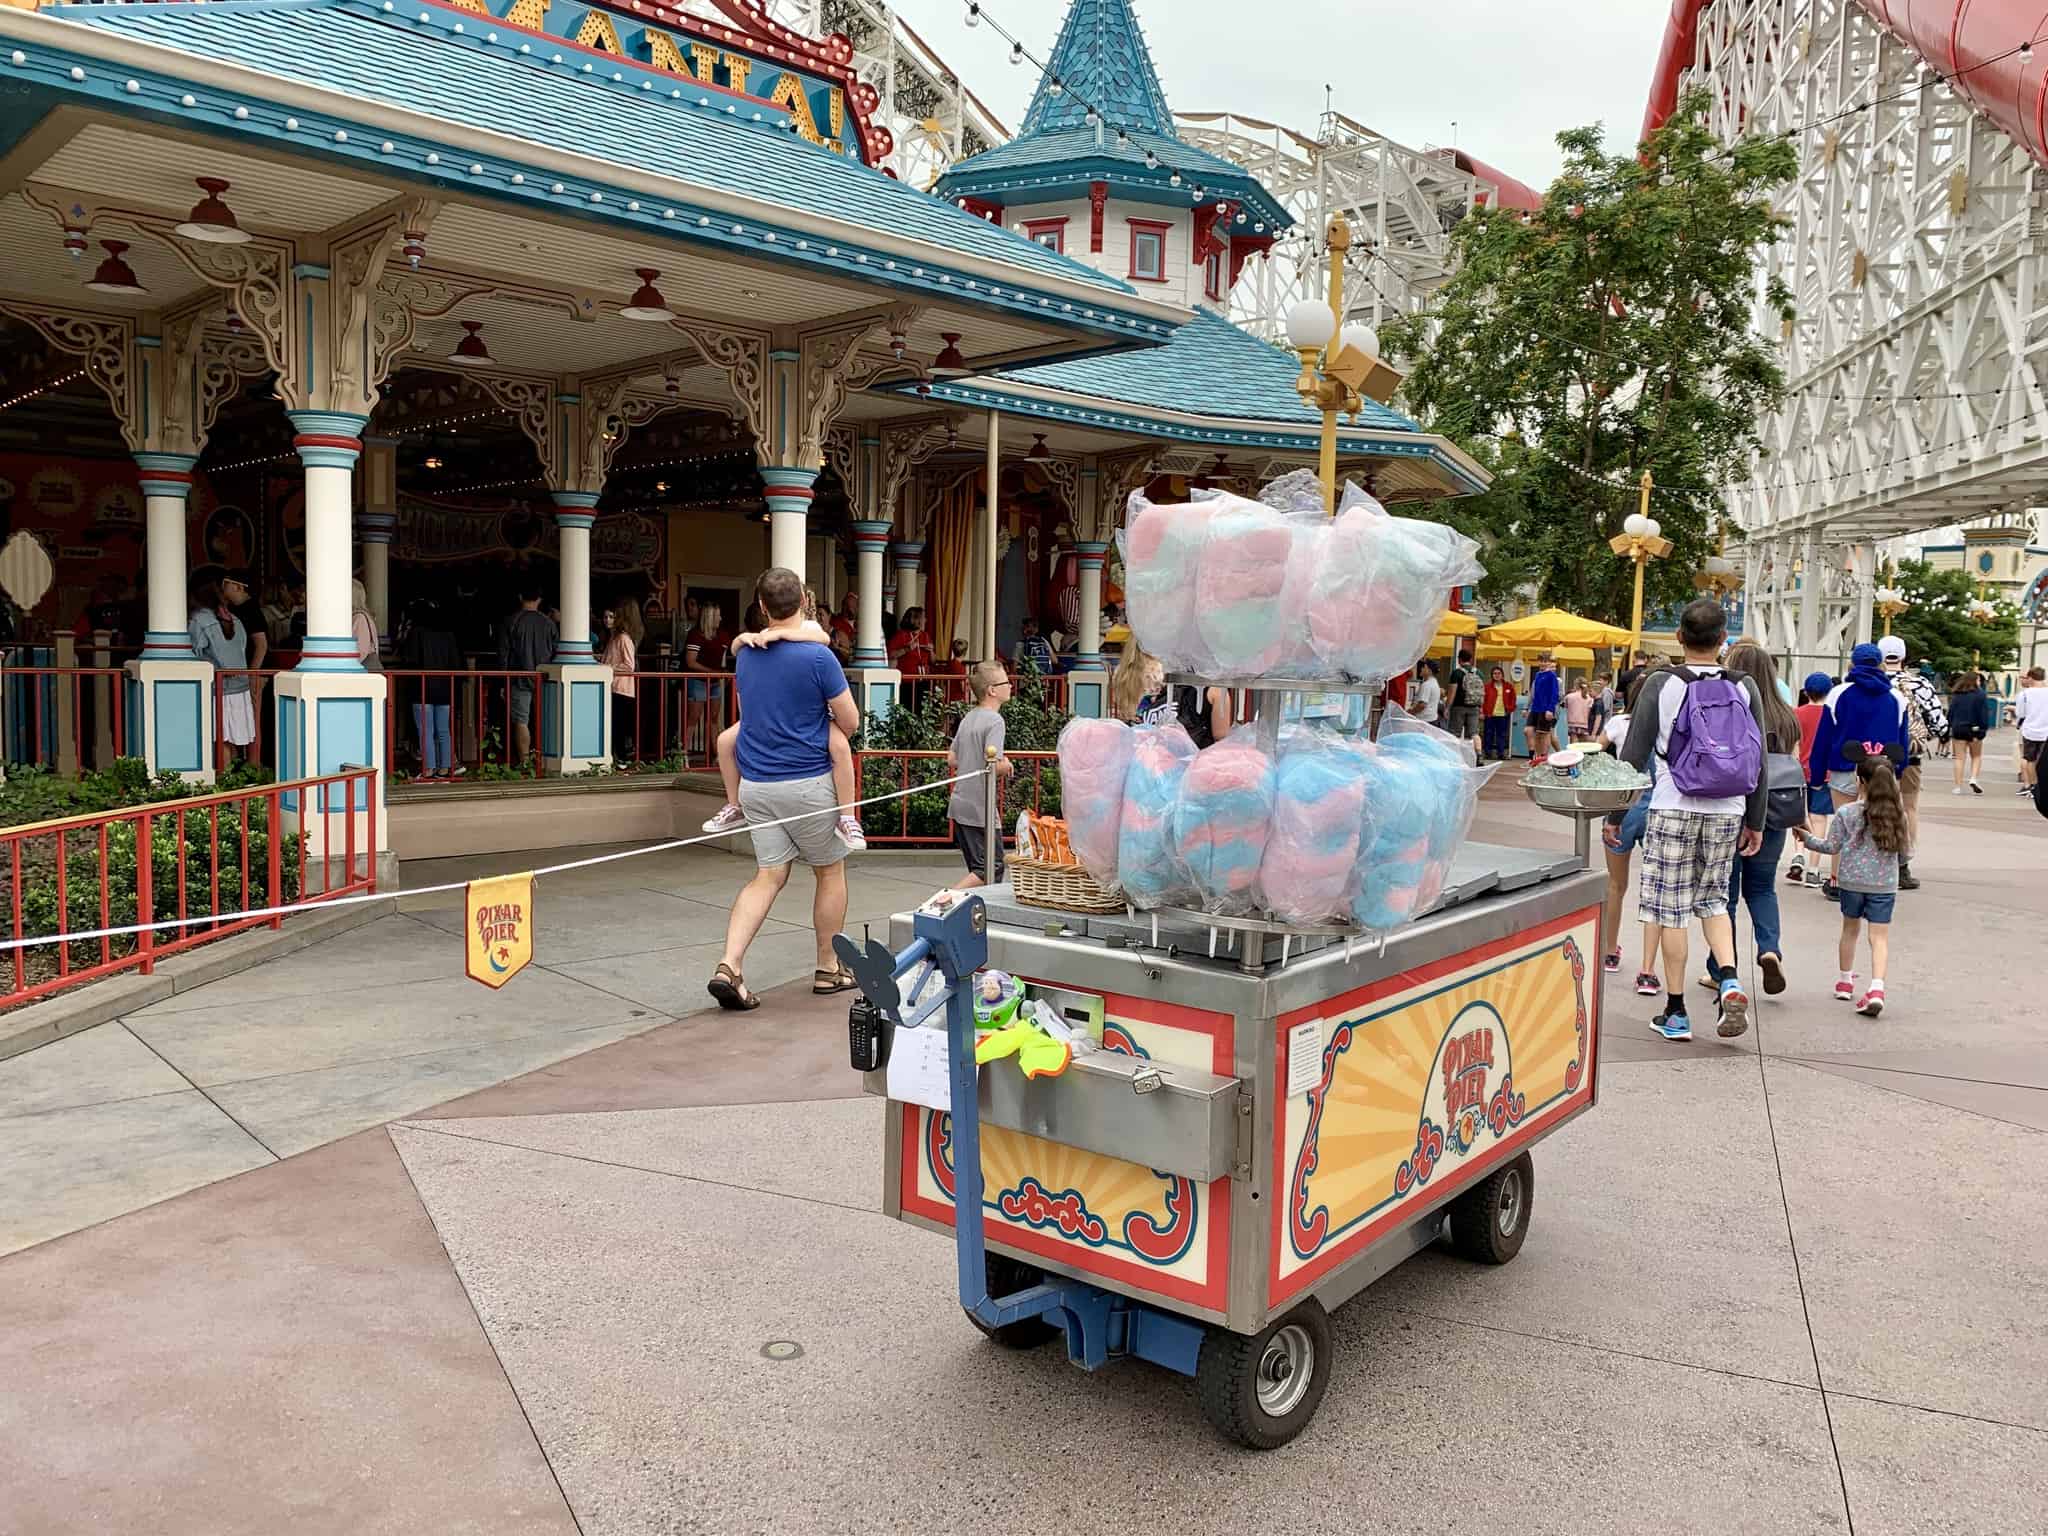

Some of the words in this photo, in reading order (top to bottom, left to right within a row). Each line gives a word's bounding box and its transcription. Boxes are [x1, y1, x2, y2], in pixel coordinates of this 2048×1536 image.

[476, 903, 522, 934] PIXAR
[481, 923, 519, 953] PIER
[1442, 1028, 1495, 1099] PIXAR
[1446, 1068, 1489, 1136] PIER
